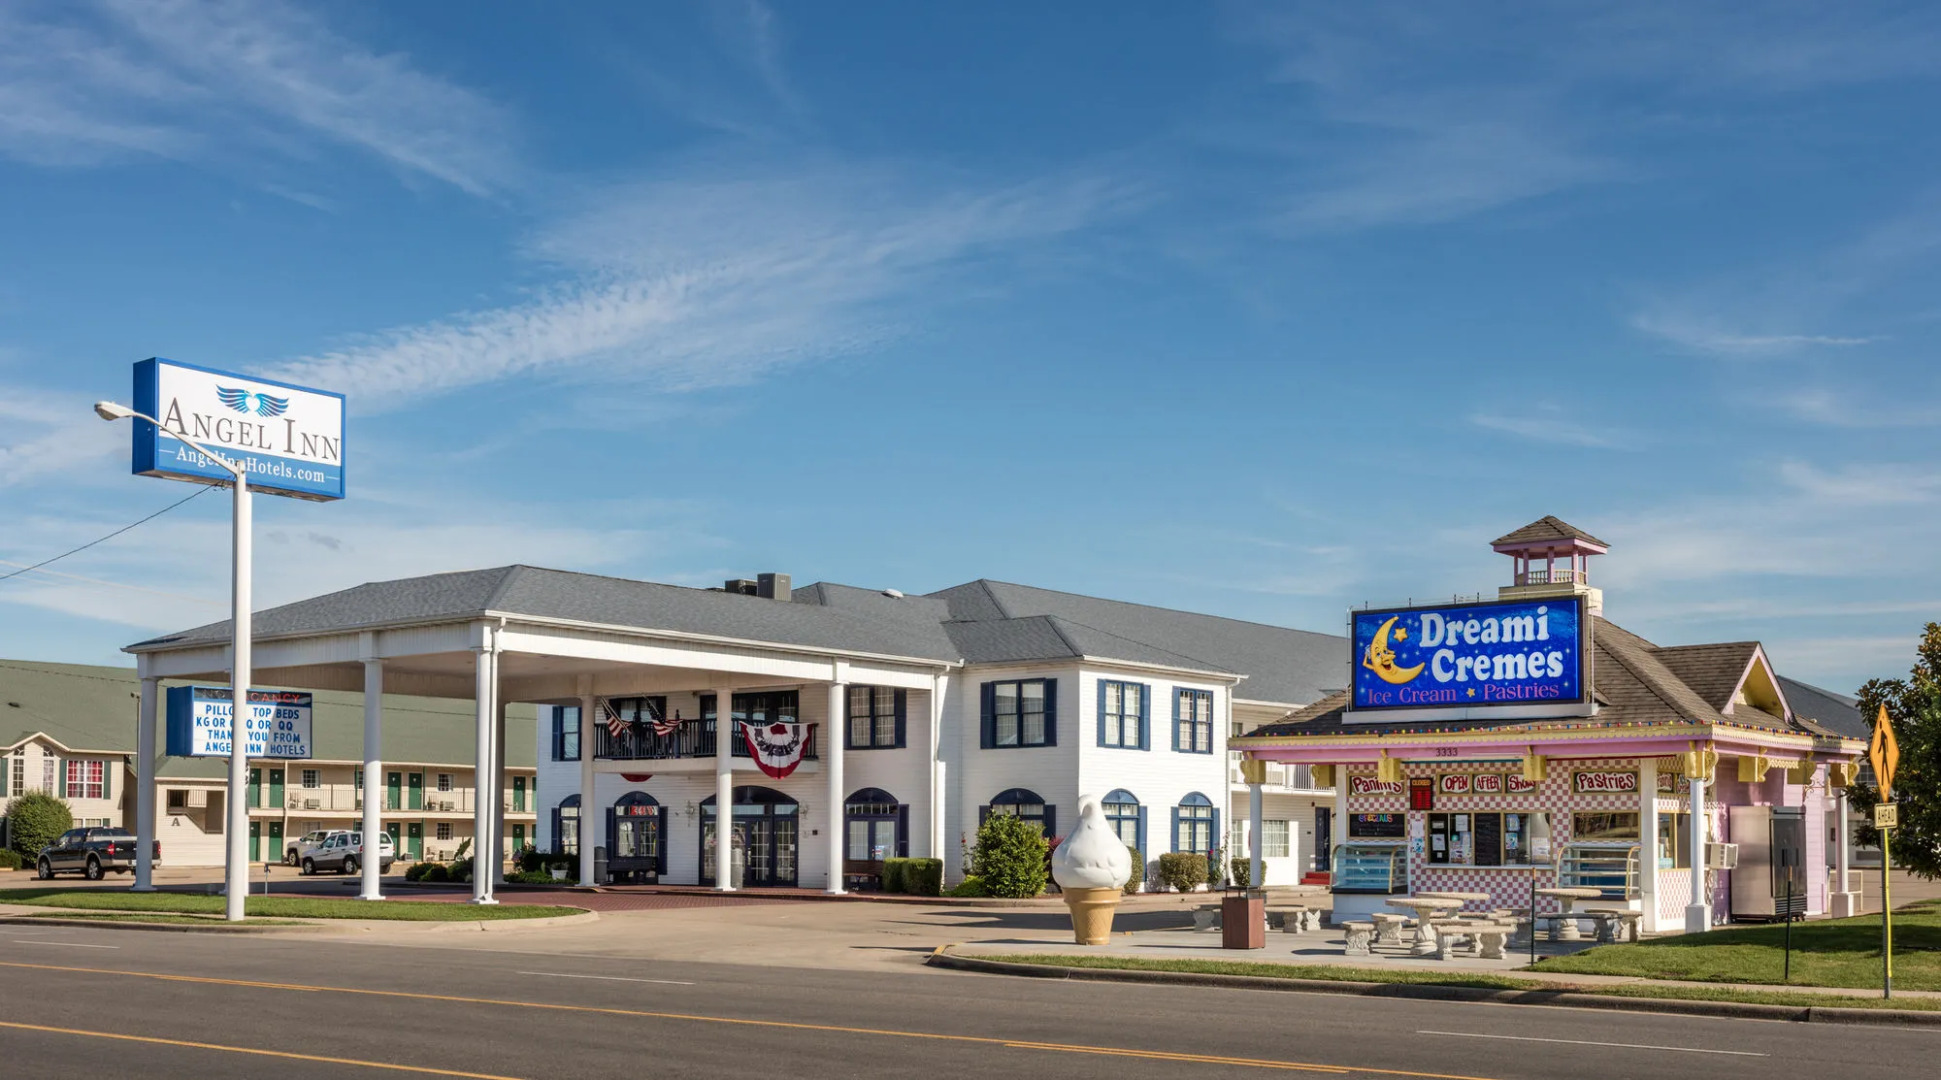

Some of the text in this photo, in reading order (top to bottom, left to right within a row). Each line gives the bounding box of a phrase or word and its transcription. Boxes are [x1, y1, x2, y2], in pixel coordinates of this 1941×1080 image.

[160, 397, 340, 461] ANGEL INN
[176, 446, 325, 483] AngelInHotels.com
[1419, 605, 1550, 648] Dreami
[1431, 649, 1564, 683] Cremes
[246, 691, 300, 704] CANCY
[1367, 682, 1560, 705] Ice Cream Pastries
[205, 704, 300, 720] PILLO TOP BEDS
[212, 717, 226, 728] OR
[258, 719, 271, 730] OR
[278, 720, 293, 731] QQ
[207, 729, 300, 743] THAN YOU FROM
[205, 741, 305, 755] ANGE INN HOTELS
[1435, 747, 1459, 757] 3333
[1445, 775, 1468, 791] OPEN
[1578, 773, 1634, 790] Pastries
[171, 817, 181, 826] A
[1878, 808, 1895, 823] AHEAD
